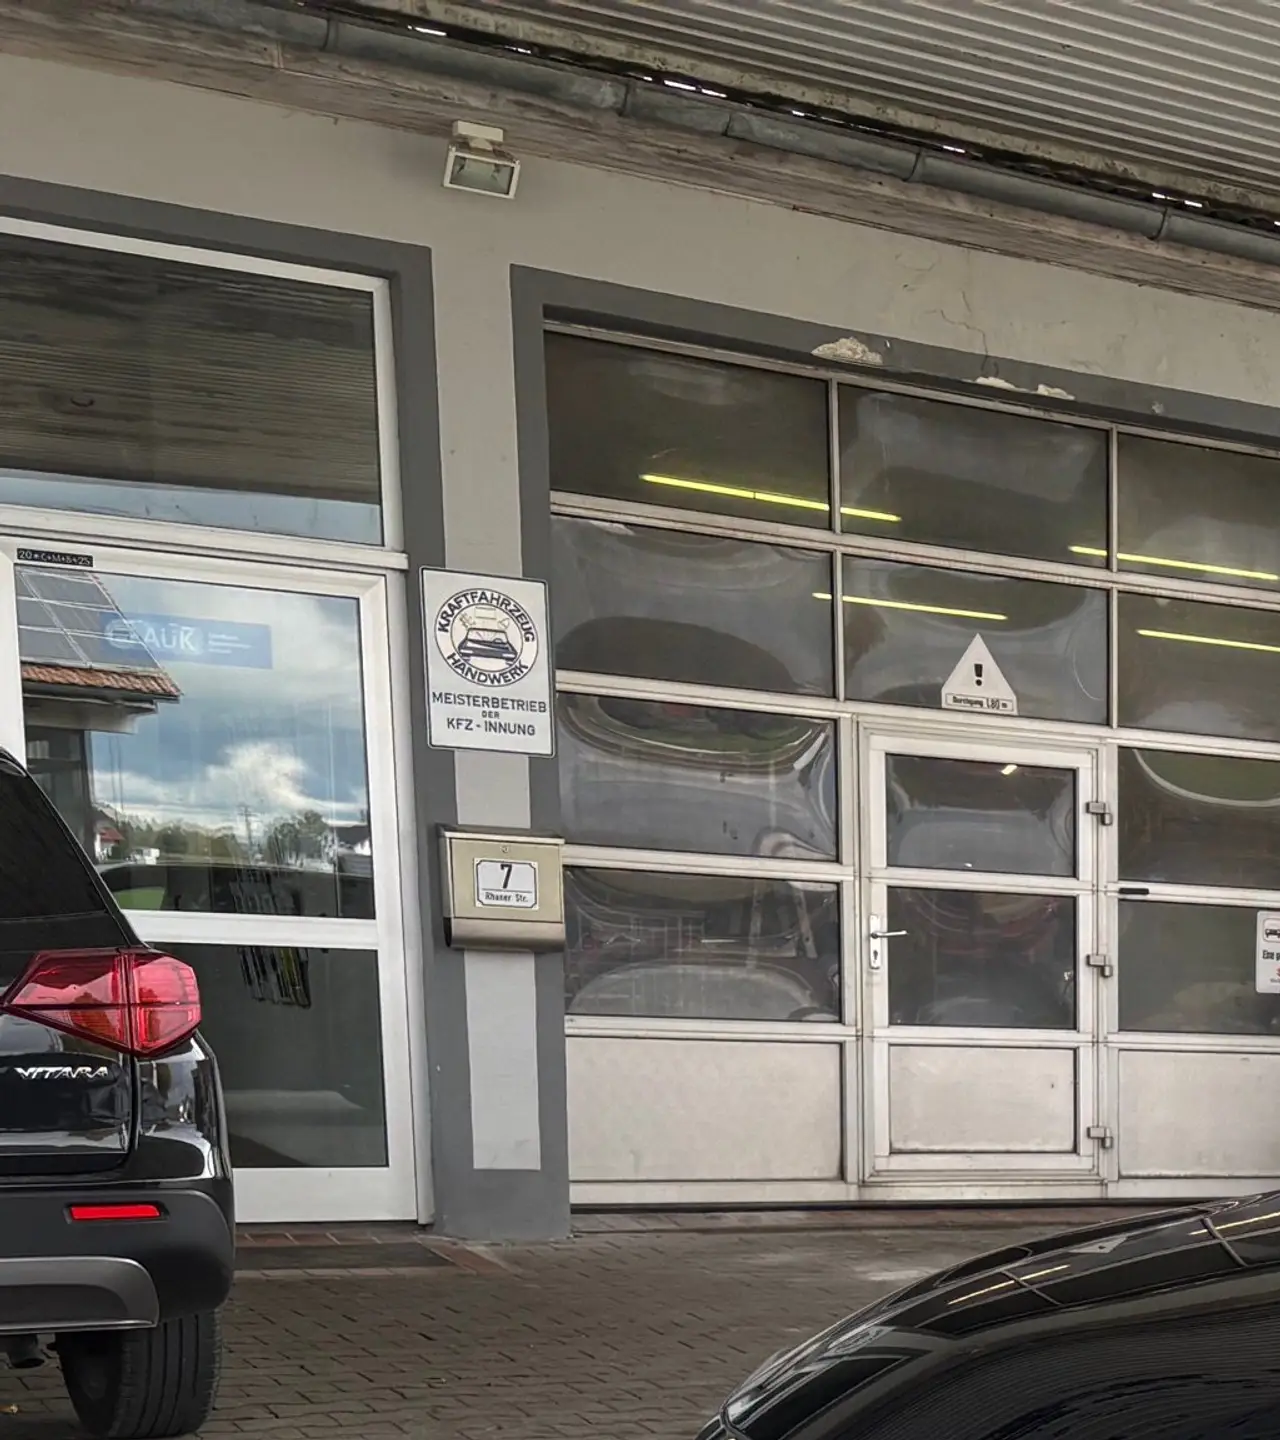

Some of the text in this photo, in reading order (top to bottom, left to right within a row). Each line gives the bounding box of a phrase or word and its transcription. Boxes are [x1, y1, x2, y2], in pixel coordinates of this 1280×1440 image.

[437, 590, 536, 643] KRAFTFAHRZEUG
[446, 651, 529, 686] HANDWERK
[431, 691, 547, 713] MEISTERBETRIEB
[481, 710, 500, 719] DER
[500, 863, 513, 889] 7
[14, 1066, 109, 1080] VITARA
